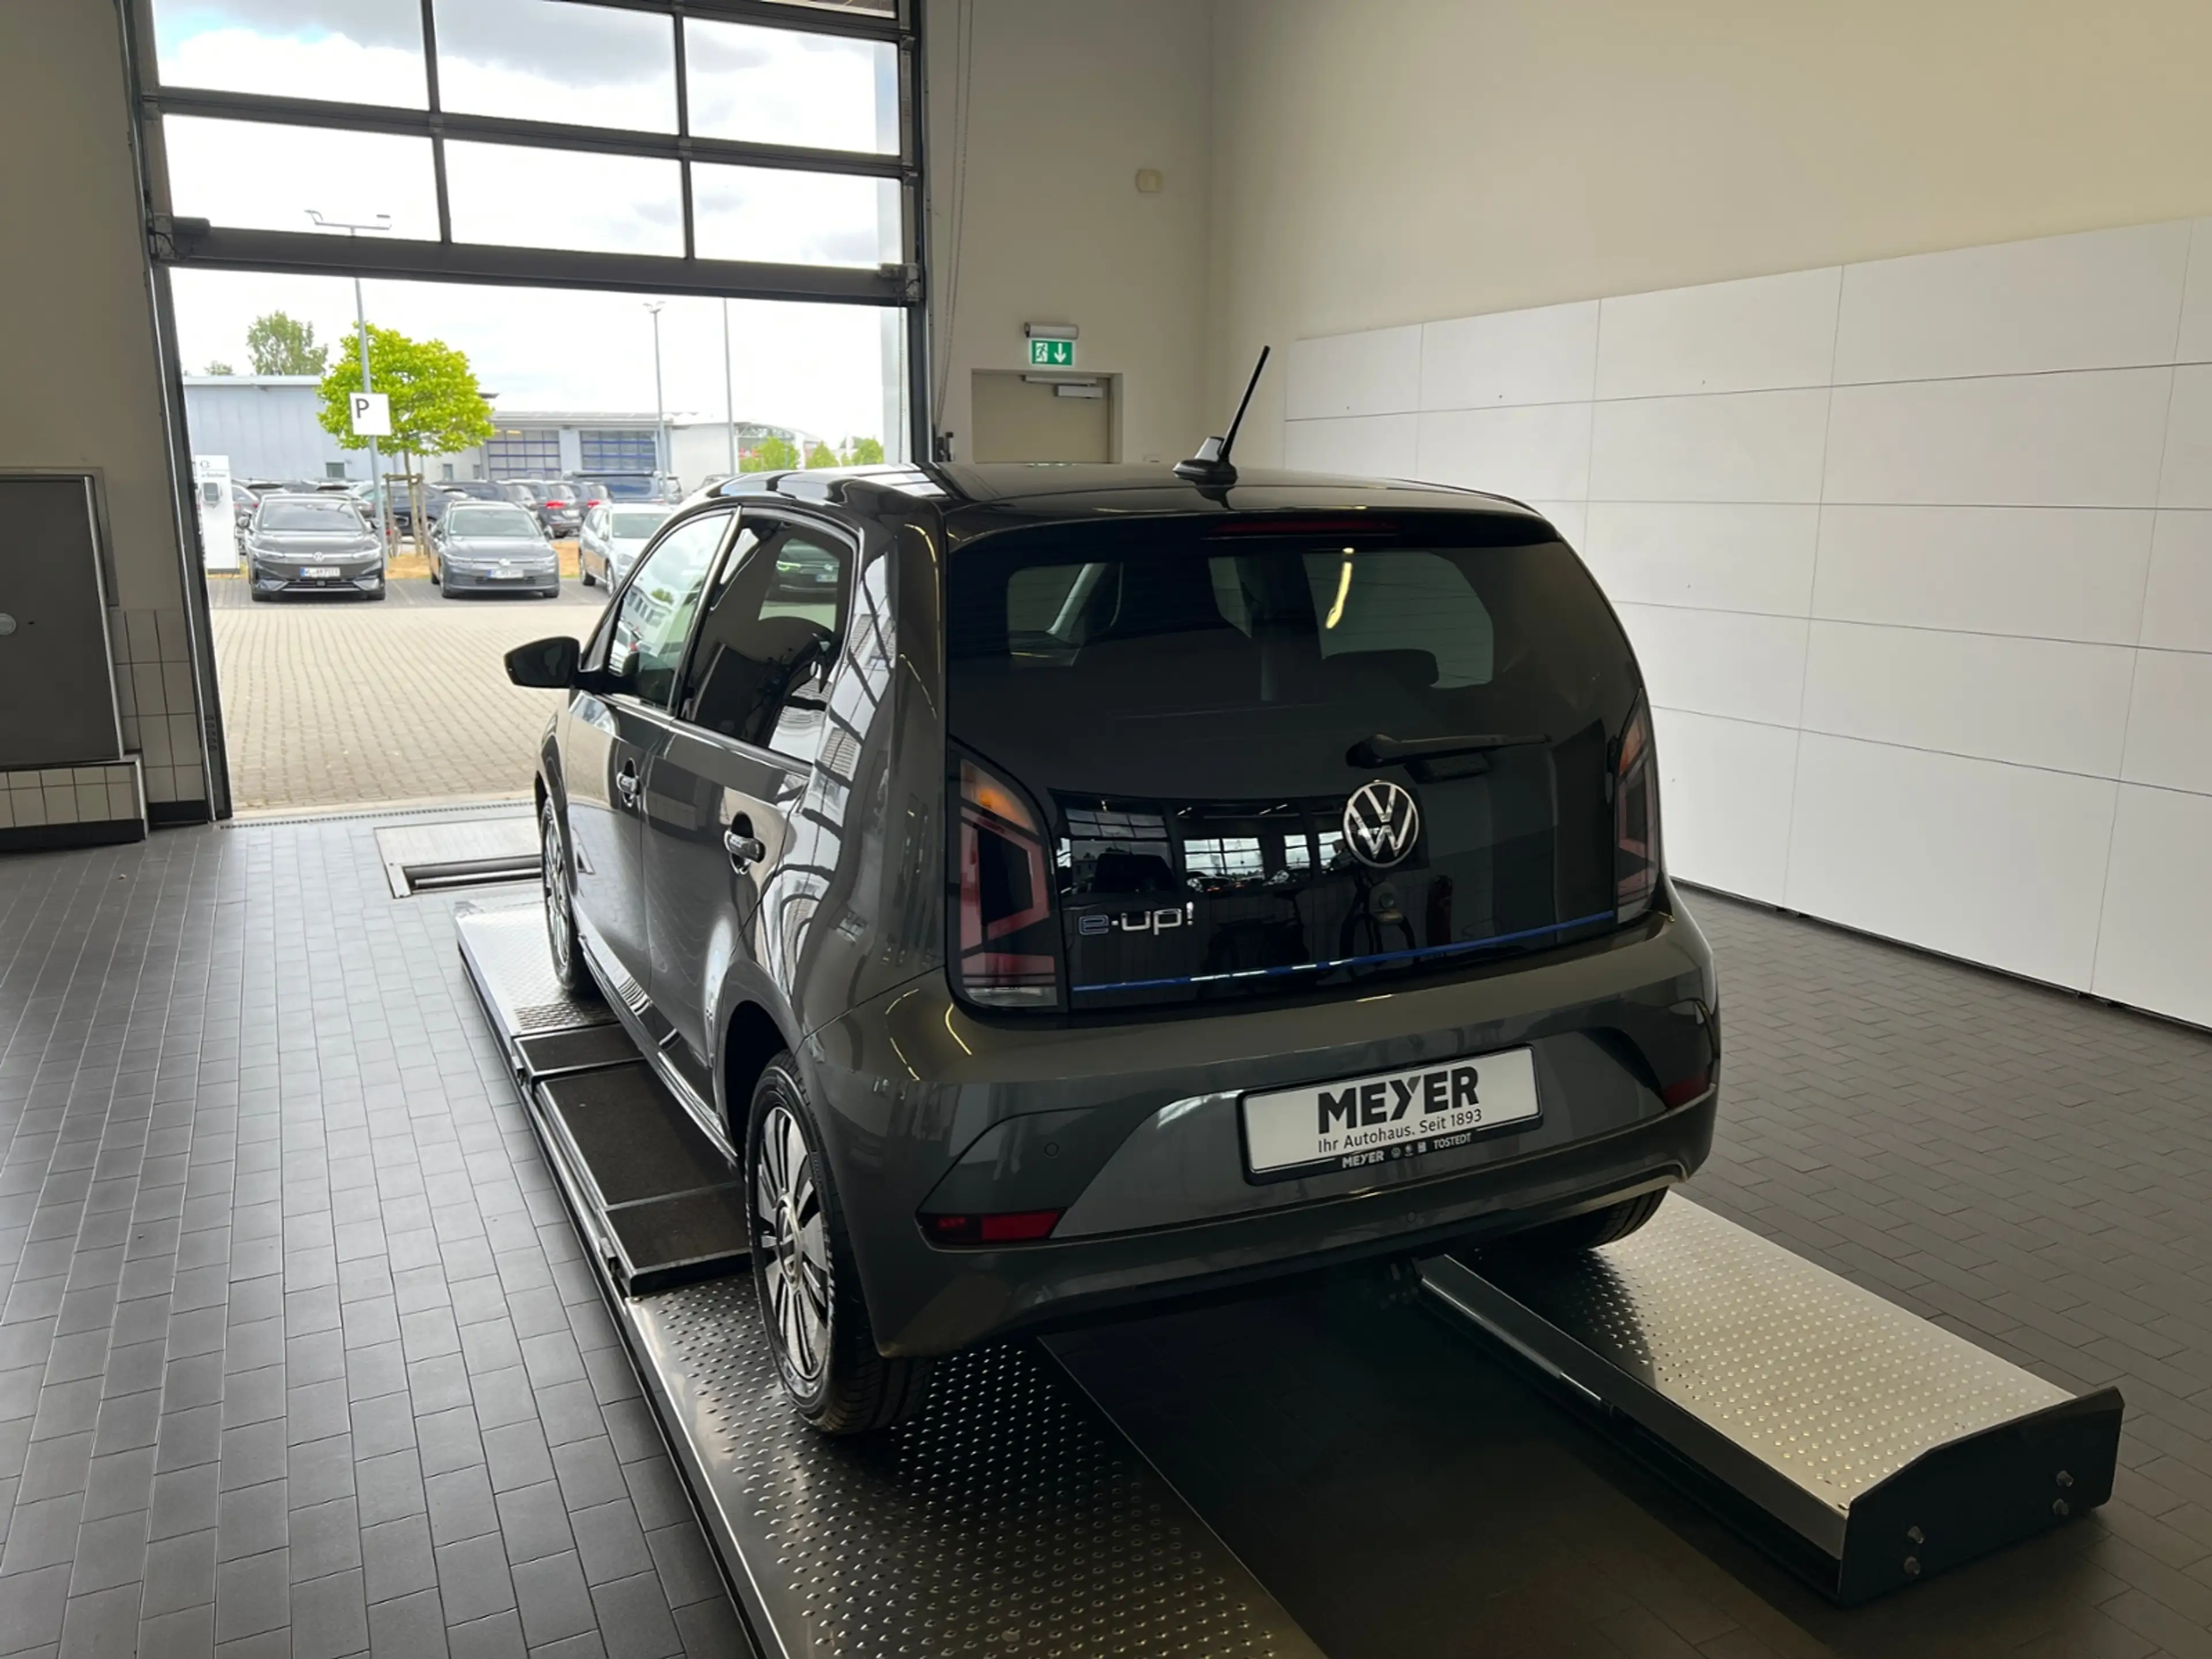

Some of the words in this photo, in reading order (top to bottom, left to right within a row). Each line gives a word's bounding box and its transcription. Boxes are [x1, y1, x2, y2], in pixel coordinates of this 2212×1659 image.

[355, 397, 370, 419] P
[1317, 1066, 1479, 1135] MEYER
[1318, 1138, 1339, 1153] Ihr
[1343, 1125, 1415, 1149] Autohaus.
[1419, 1116, 1447, 1134] Seit
[1450, 1108, 1482, 1128] 1893
[1342, 1150, 1384, 1169] MEYER
[1433, 1132, 1472, 1150] TOSTEDT
